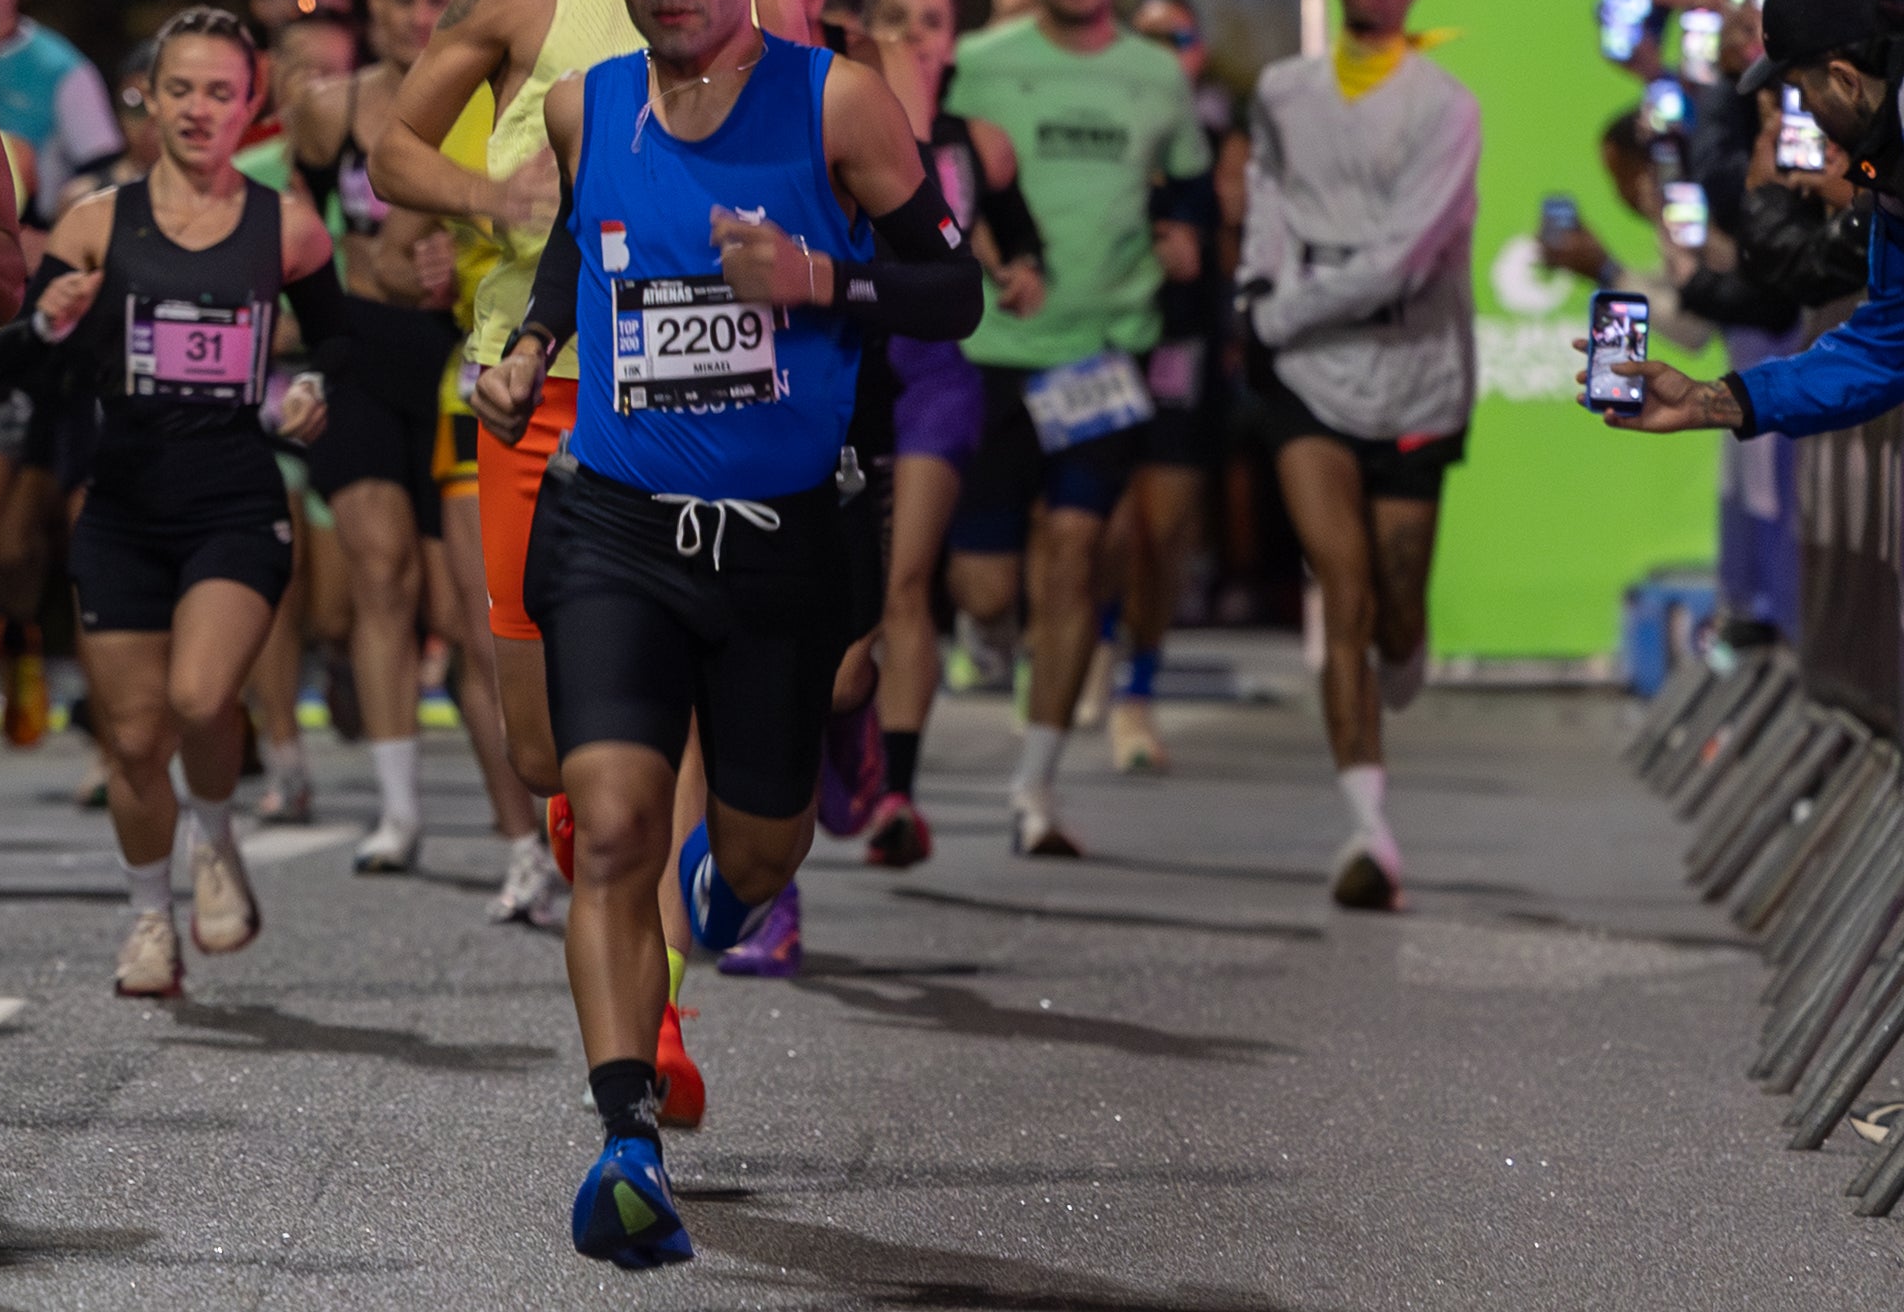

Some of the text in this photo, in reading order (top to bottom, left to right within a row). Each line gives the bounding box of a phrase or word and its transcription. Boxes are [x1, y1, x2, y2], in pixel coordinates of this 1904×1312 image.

[618, 319, 640, 336] TOP
[656, 310, 764, 358] 2209
[186, 331, 223, 363] 31
[693, 360, 732, 374] MIKAEL
